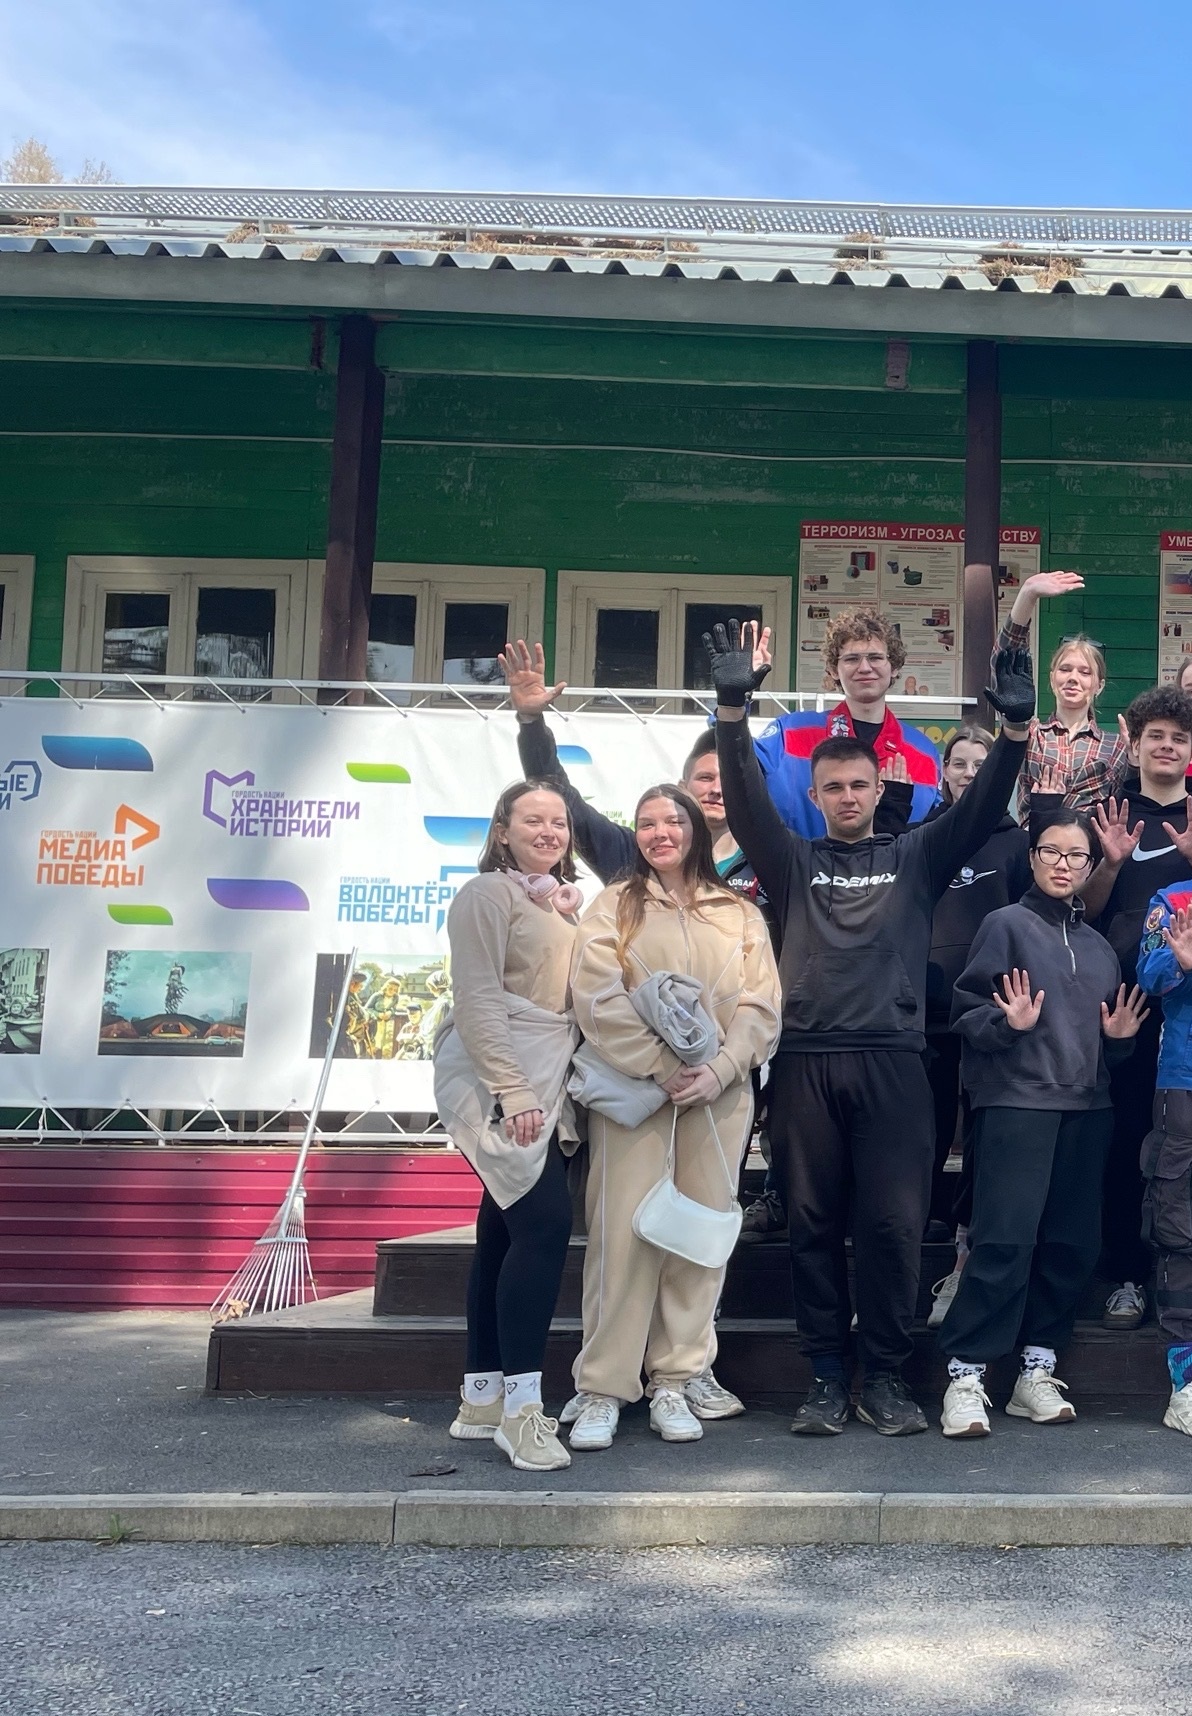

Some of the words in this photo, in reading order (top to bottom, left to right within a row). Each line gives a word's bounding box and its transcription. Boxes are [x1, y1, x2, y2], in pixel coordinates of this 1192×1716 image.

[802, 525, 888, 538] ТЕРРОРИЗМ
[900, 527, 953, 540] УГРОЗА
[958, 528, 1037, 543] ОСТВУ
[232, 790, 263, 798] ГОРДОСТЬ
[231, 799, 360, 819] ХРАНИТЕЛИ
[41, 830, 74, 838] ГОРДОСТЬ
[230, 818, 331, 838] ИСТОРИИ
[39, 838, 126, 862] МЕДИА
[37, 863, 144, 888] ПОБЕДЫ
[832, 873, 896, 888] DEMIX
[338, 904, 430, 925] ПОБЕДЫ
